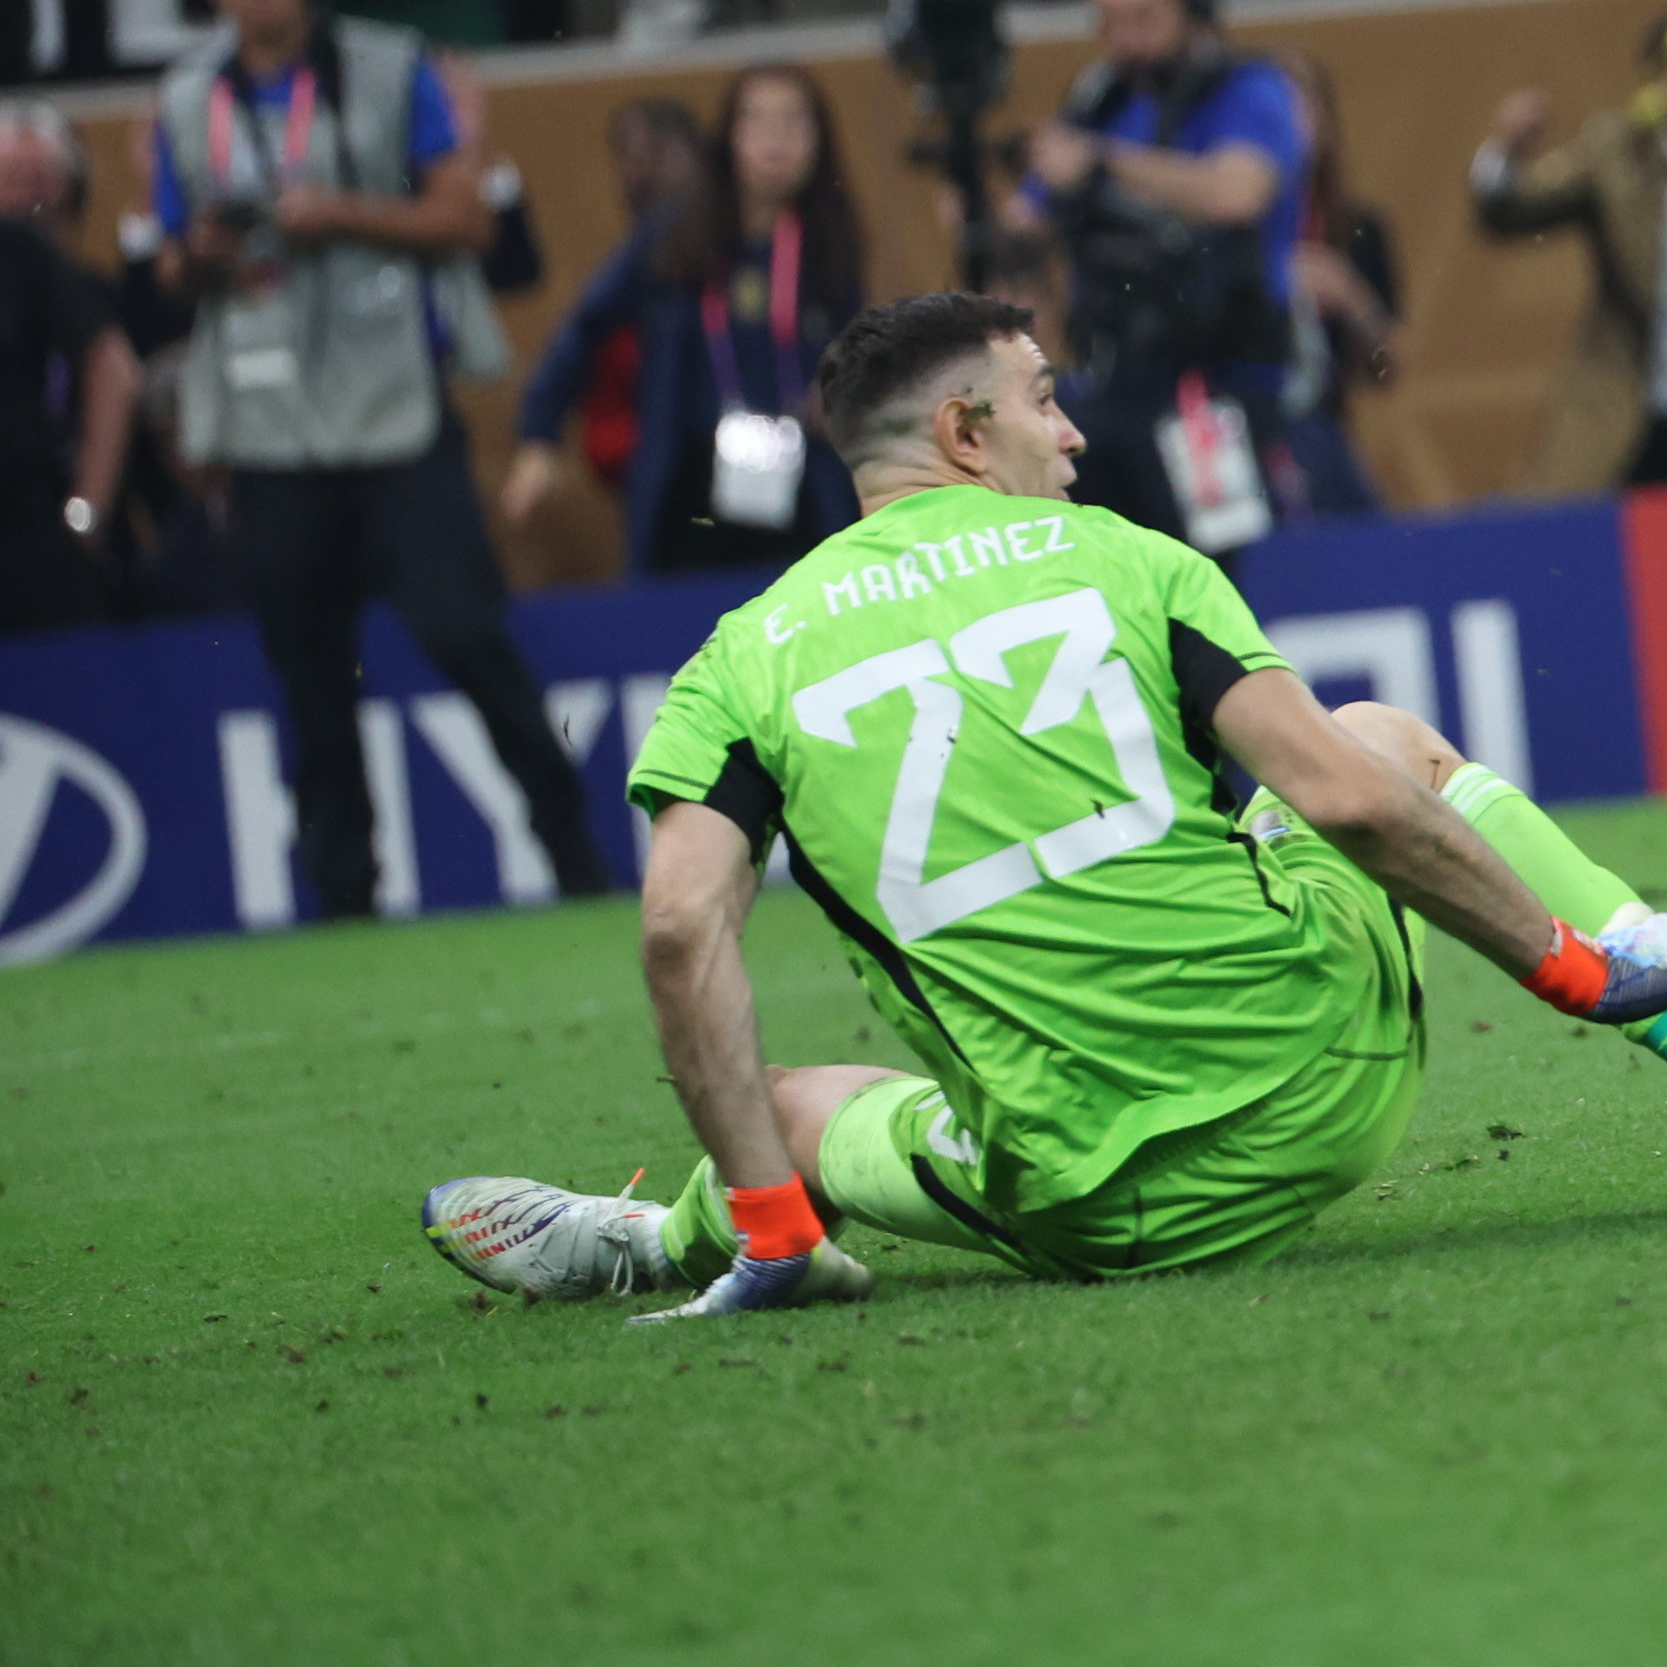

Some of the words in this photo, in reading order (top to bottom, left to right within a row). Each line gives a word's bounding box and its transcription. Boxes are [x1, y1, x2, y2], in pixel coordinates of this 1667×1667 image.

[763, 602, 808, 646] E.
[820, 514, 1077, 617] MARTINEZ
[791, 586, 1177, 946] 23
